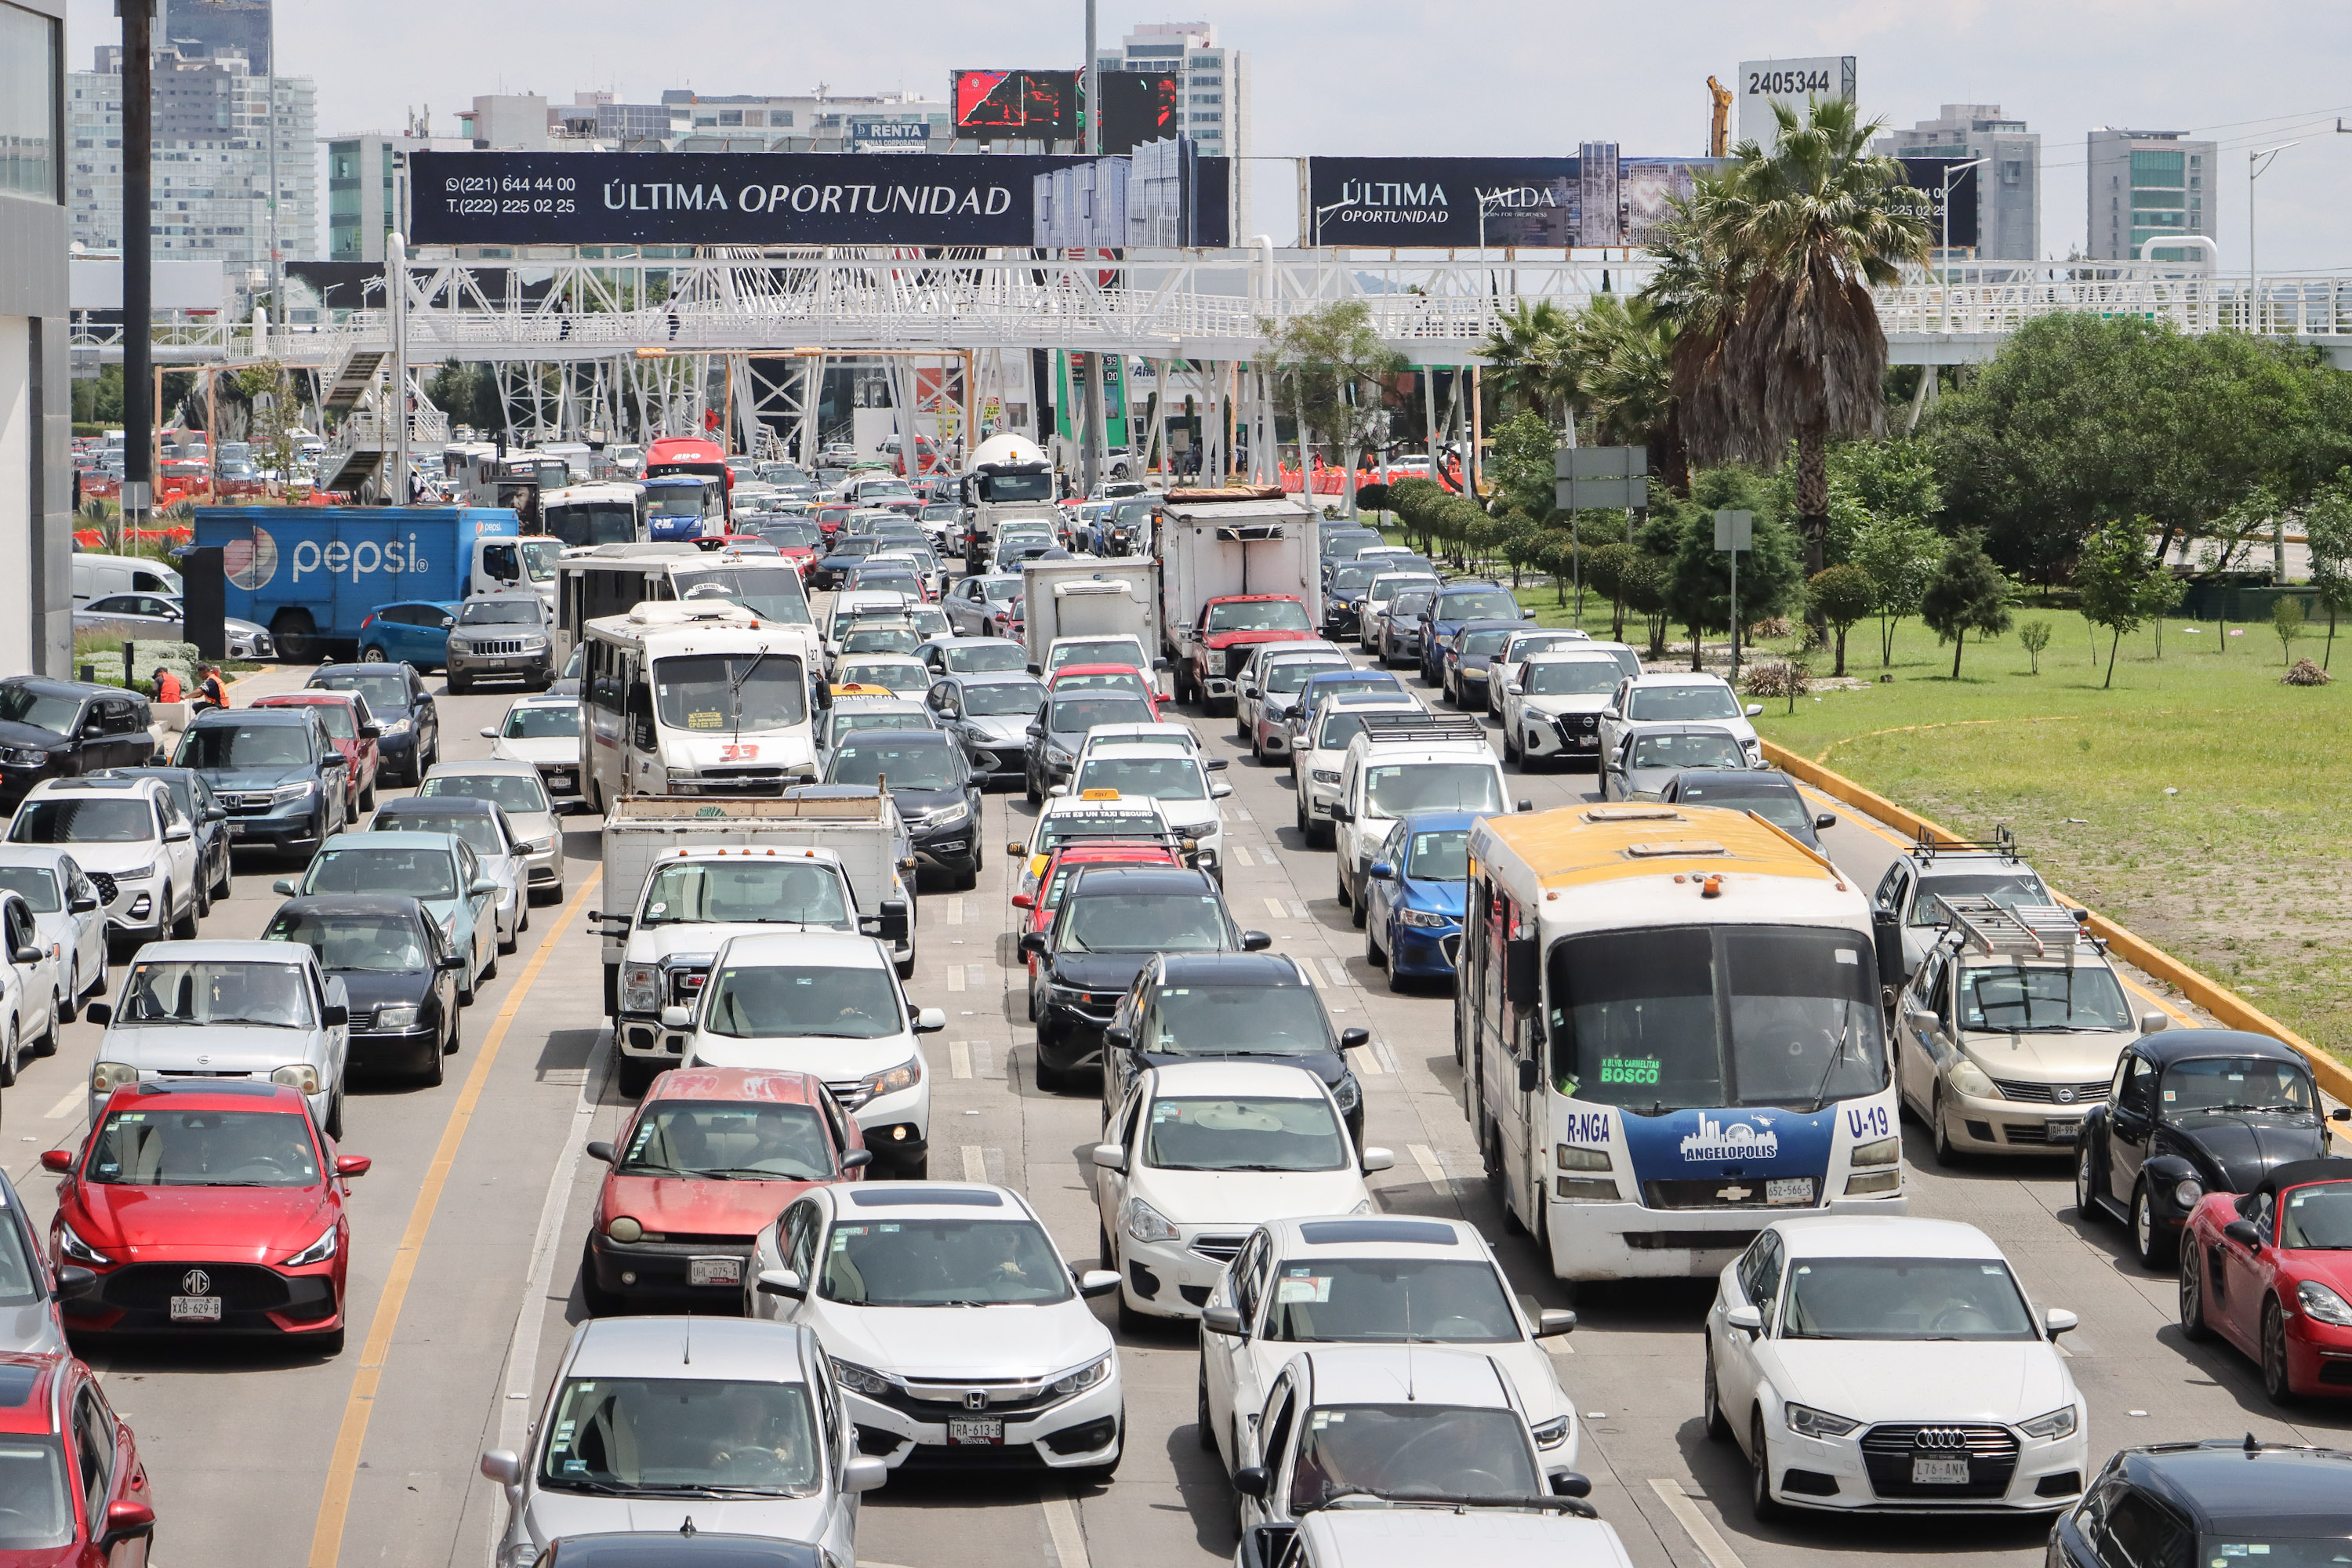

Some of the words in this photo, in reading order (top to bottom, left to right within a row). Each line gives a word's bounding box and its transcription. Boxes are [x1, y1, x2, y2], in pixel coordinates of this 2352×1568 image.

[1749, 71, 1829, 94] 2405344
[871, 125, 921, 136] RENTA
[460, 177, 498, 194] (221)
[503, 177, 530, 191] 644
[534, 177, 554, 191] 44
[557, 177, 575, 191] 00
[1343, 178, 1448, 205] ÚLTIMA
[604, 178, 728, 210] ÚLTIMA
[738, 184, 1011, 215] OPORTUNIDAD
[1474, 187, 1556, 208] VALDA
[502, 199, 530, 213] 225
[533, 199, 553, 213] 02
[556, 199, 575, 213] 25
[1341, 210, 1449, 223] OPORTUNIDAD
[485, 522, 501, 533] pepsi
[292, 533, 416, 583] pepsi
[720, 745, 760, 761] 33
[1009, 843, 1020, 852] 061
[1184, 840, 1196, 850] 061
[905, 858, 915, 867] 131
[1602, 1058, 1607, 1067] X
[1607, 1058, 1624, 1068] BLVD.
[1624, 1059, 1660, 1069] CARMELITAS
[1601, 1068, 1658, 1083] BOSCO
[1567, 1113, 1610, 1143] R-NGA
[1849, 1106, 1889, 1139] U-19
[1686, 1145, 1777, 1161] ANGELOPOLIS
[1768, 1184, 1812, 1196] 652-566-S
[693, 1267, 738, 1277] UHL-075-A
[184, 1271, 209, 1294] MG
[172, 1303, 219, 1314] XXB-629-B
[951, 1425, 1001, 1436] TRA-613-B
[1917, 1462, 1965, 1475] L76-ANK
